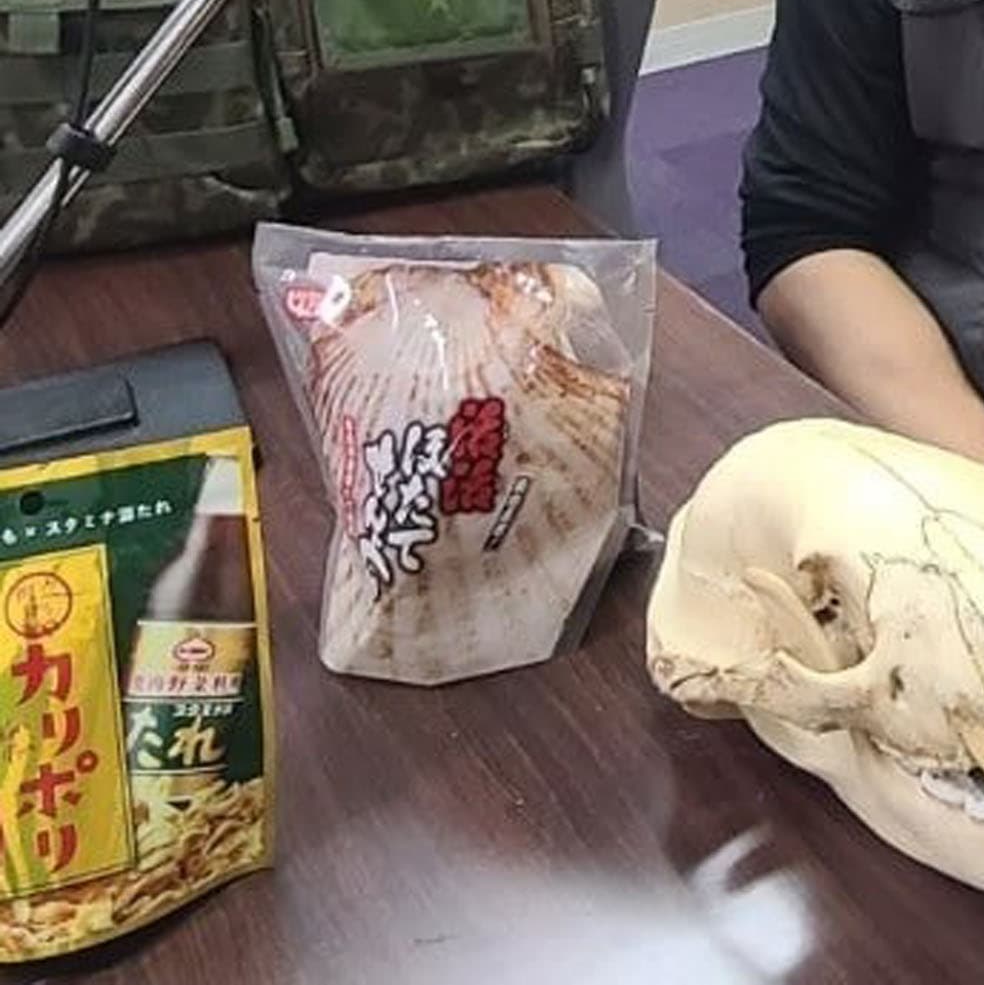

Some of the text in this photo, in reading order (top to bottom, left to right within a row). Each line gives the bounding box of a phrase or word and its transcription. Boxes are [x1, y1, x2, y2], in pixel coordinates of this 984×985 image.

[10, 643, 99, 873] カリポリ
[126, 706, 227, 768] たれ
